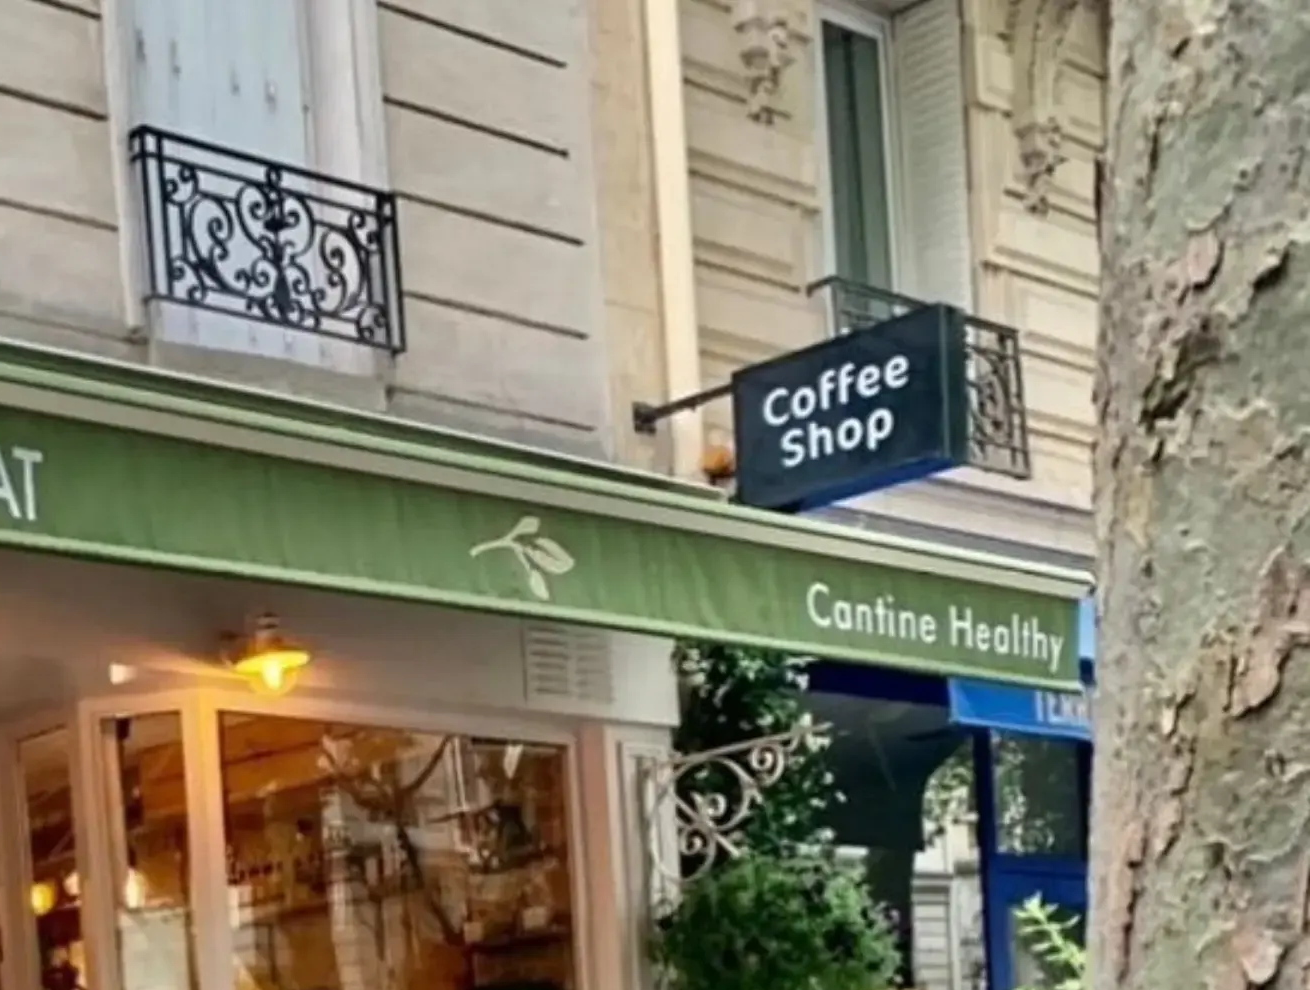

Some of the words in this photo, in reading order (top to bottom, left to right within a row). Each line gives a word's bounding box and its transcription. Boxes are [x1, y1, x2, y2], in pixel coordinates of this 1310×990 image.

[762, 353, 911, 427] Coffee
[779, 407, 895, 468] Shop
[806, 581, 938, 643] Cantine
[948, 605, 1066, 673] Healthy
